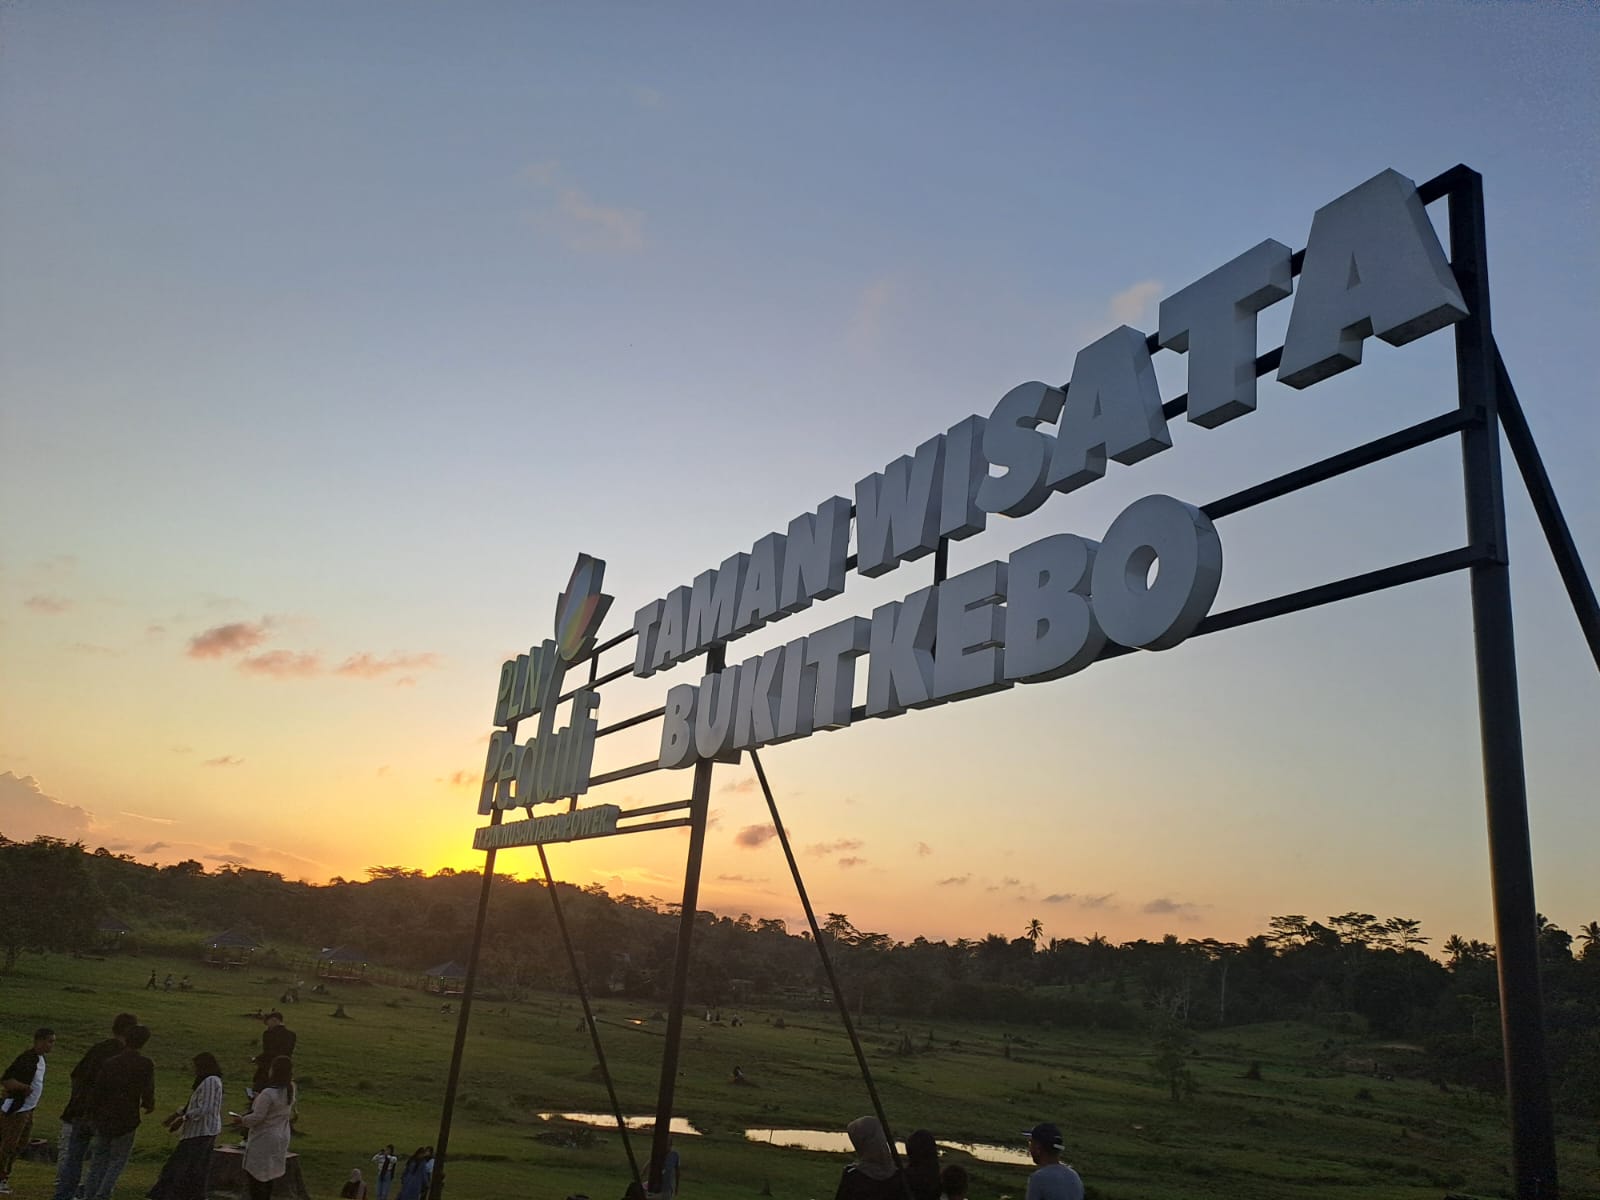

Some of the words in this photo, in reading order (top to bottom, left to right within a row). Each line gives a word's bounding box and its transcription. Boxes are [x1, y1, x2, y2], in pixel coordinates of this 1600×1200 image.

[633, 495, 852, 678] TAMAN
[855, 168, 1469, 578] WISATA
[494, 638, 556, 726] PLN
[658, 616, 872, 770] BUKIT
[866, 494, 1222, 719] KEBO
[500, 816, 561, 846] NUSANTARA
[562, 806, 612, 838] POWER
